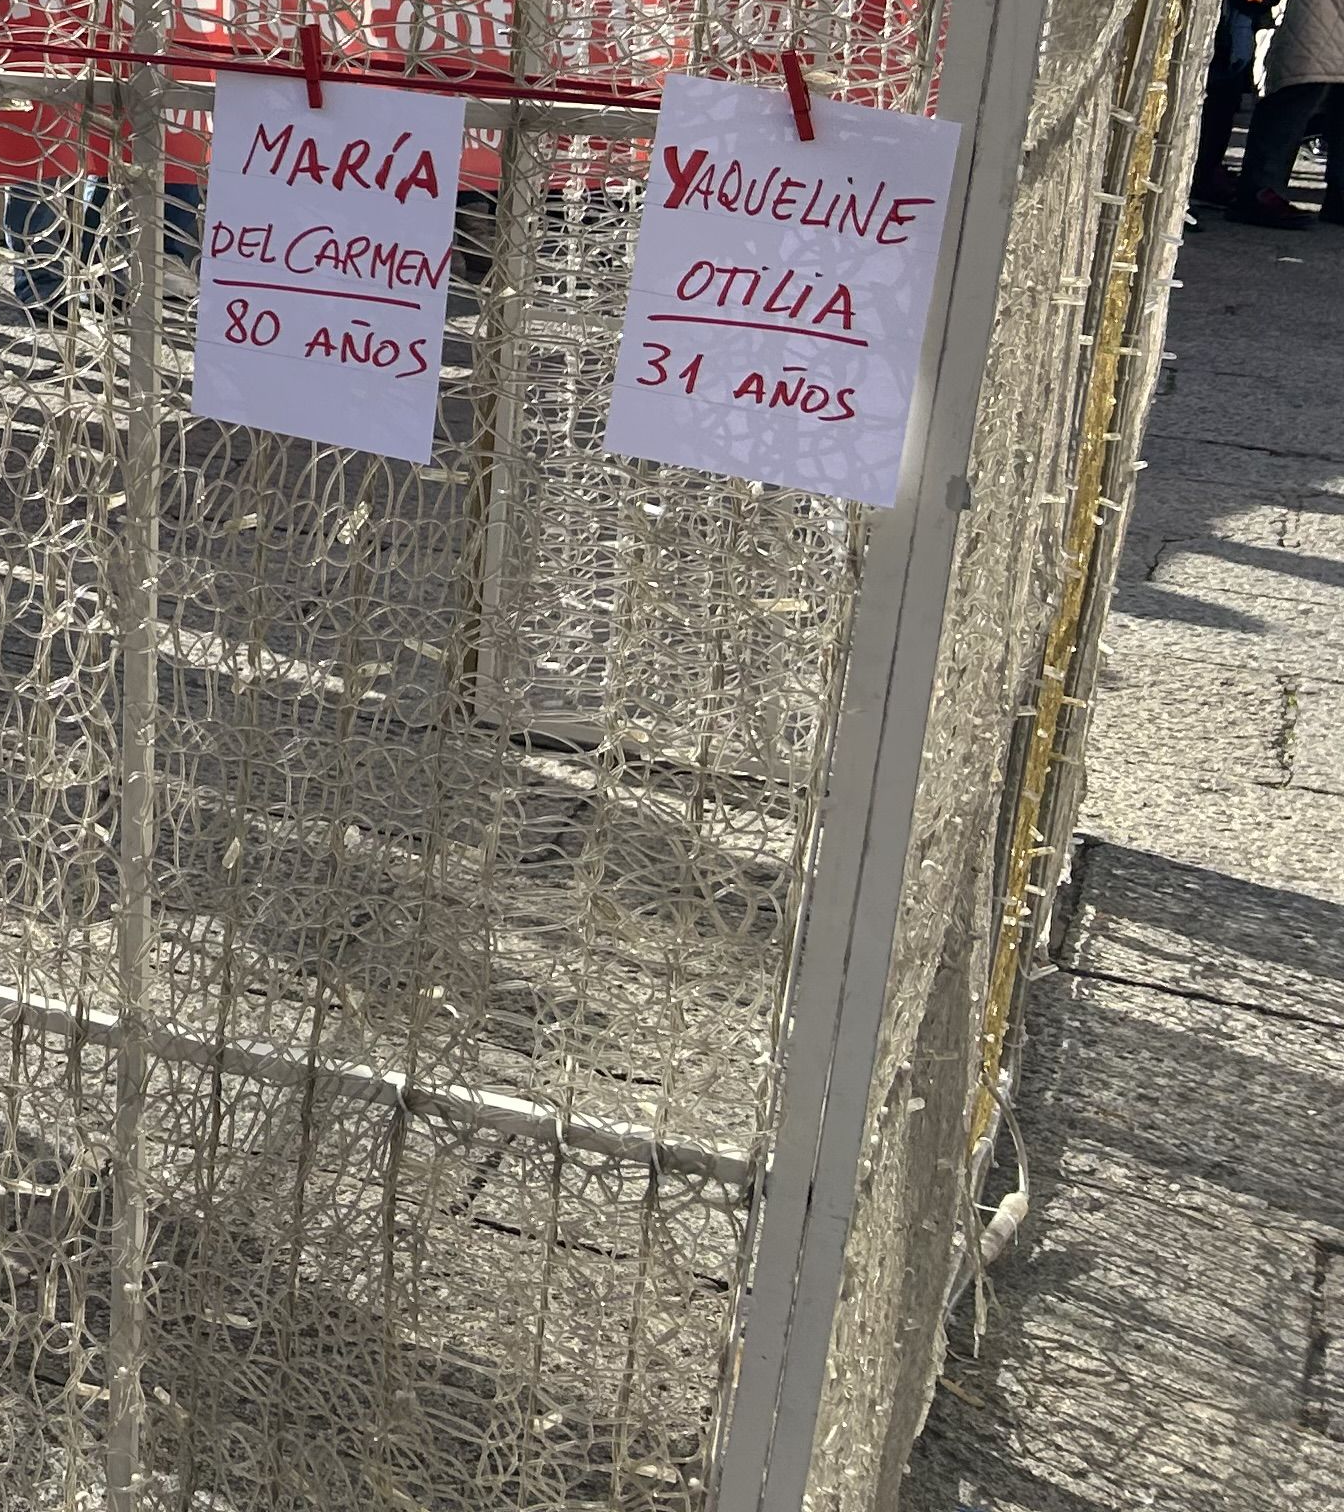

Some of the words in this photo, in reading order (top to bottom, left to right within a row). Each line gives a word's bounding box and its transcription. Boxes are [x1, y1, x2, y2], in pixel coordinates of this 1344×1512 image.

[242, 123, 439, 204] MARÍA
[662, 143, 937, 246] YAQUELINE
[285, 226, 452, 290] CARMEN
[676, 261, 856, 330] OTILIA
[223, 298, 282, 347] 80
[305, 319, 429, 379] AÑOS
[638, 341, 703, 396] 31
[732, 366, 857, 422] AÑOS
